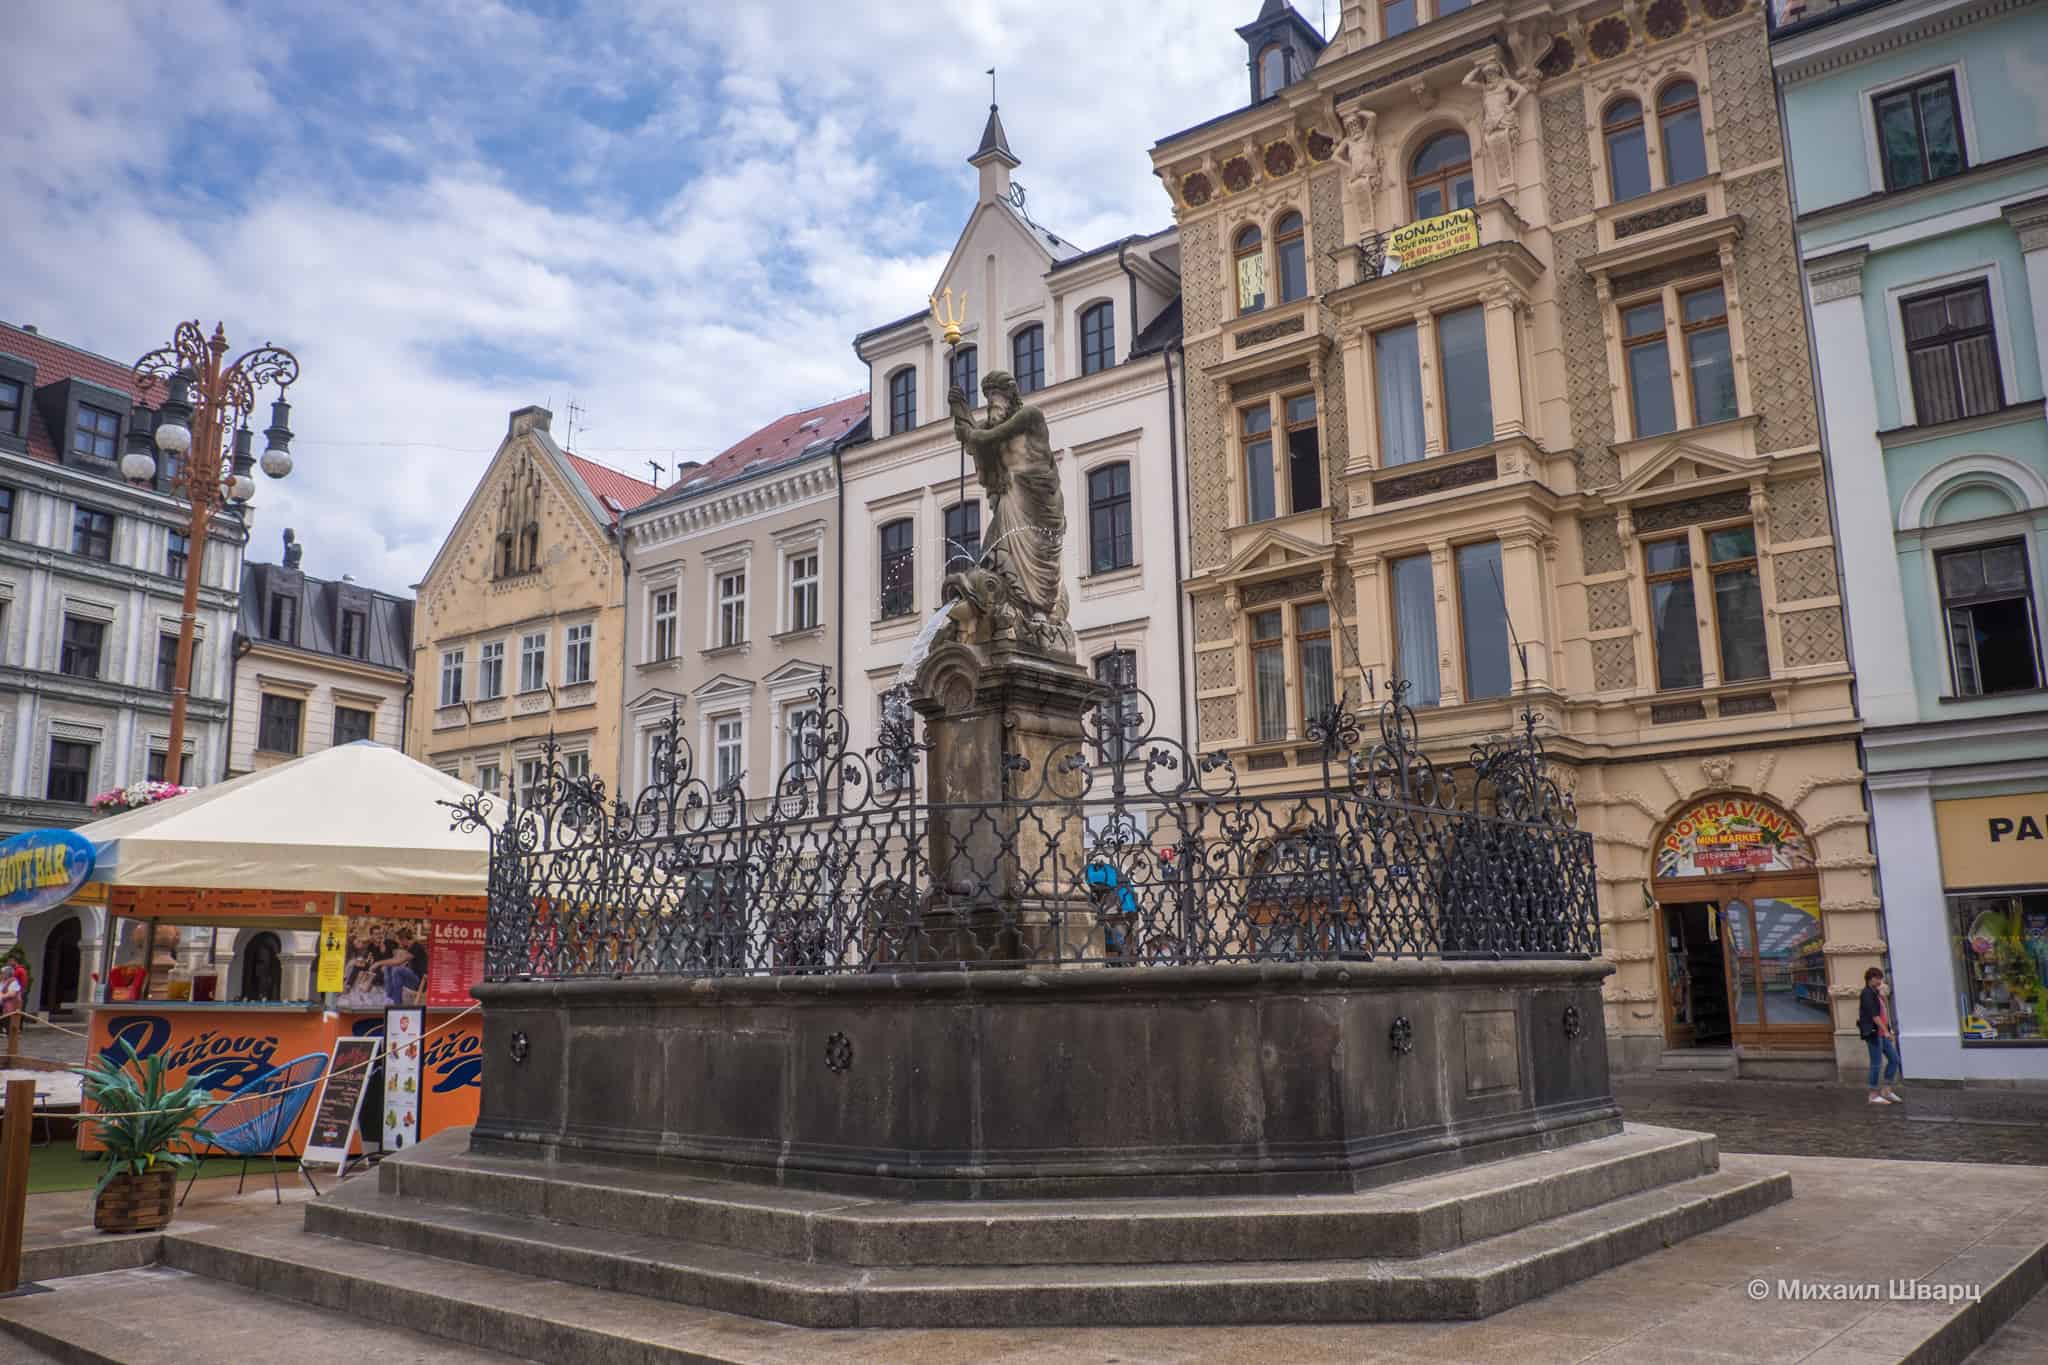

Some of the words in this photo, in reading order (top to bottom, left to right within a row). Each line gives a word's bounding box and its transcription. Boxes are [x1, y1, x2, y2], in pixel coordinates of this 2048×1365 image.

[1664, 800, 1798, 851] POTRAVINY
[1697, 835, 1718, 846] MINI
[1719, 832, 1763, 844] MARKET
[1990, 814, 2048, 842] PA
[35, 844, 69, 888] BAR
[435, 923, 469, 938] Léto
[100, 1015, 279, 1071] Pážový
